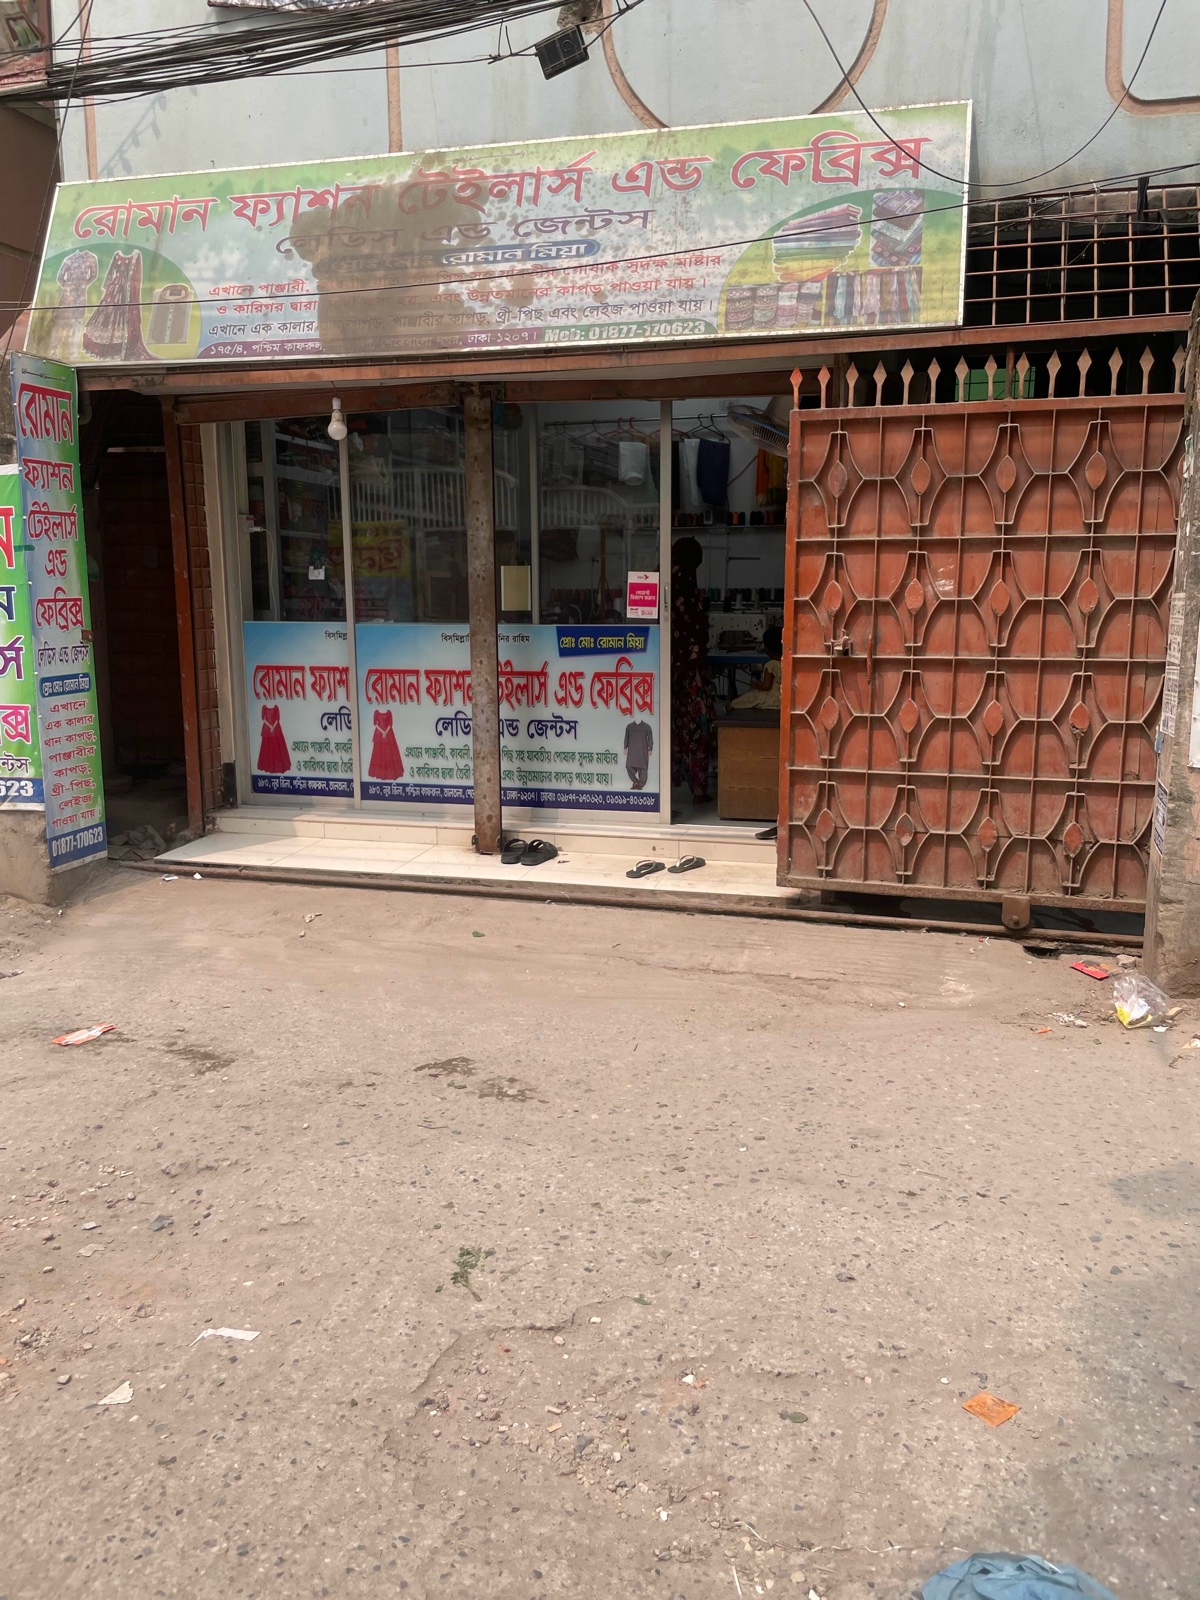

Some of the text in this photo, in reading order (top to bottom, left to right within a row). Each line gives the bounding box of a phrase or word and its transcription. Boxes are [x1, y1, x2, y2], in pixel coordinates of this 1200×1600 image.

[74, 195, 220, 239] রোমান
[228, 181, 384, 227] ফ্যাশন
[398, 151, 597, 213] টেইলার্স
[731, 131, 932, 187] ফেব্রিক্স
[276, 226, 405, 254] লেডিস
[514, 207, 657, 237] জেন্টস
[442, 247, 525, 265] রোমান
[529, 242, 587, 259] মিয়া
[627, 256, 667, 274] সুদক্ষ
[209, 283, 253, 296] এখানে
[258, 278, 310, 295] পাঞ্জাবী,
[216, 304, 228, 315] ও
[234, 301, 285, 314] কারিগর
[290, 300, 318, 312] দ্বারা
[430, 293, 462, 303] এবং
[467, 287, 550, 303] উন্নতমানের
[556, 283, 604, 297] কাপড়
[610, 279, 658, 293] পাওয়া
[209, 323, 247, 337] এখানে
[251, 322, 273, 335] এক
[278, 320, 316, 334] কালার
[449, 312, 491, 328] কাপড়,
[549, 306, 577, 320] এবং
[582, 301, 625, 318] লেইজ
[630, 301, 674, 315] পাওয়া
[544, 321, 706, 342] Mob: 01877-170623
[252, 343, 281, 354] পশ্চিম
[16, 382, 74, 445] রোমান
[21, 457, 74, 492] ফ্যাশন
[27, 500, 78, 541] টেইলার্স
[36, 586, 84, 631] ফেব্রিক্স
[512, 633, 530, 643] রাহিম
[560, 633, 645, 650] প্রোঃ মোঃ রোমান মিয়া
[38, 641, 57, 668] লেডিস
[253, 665, 306, 700] রোমান
[365, 668, 421, 704] রোমান
[590, 655, 655, 716] ফেব্রিক্স
[50, 698, 87, 714] এখানে
[45, 714, 94, 731] এক কালার
[435, 711, 472, 739] লেডি
[527, 712, 579, 740] জেন্টস
[44, 730, 97, 748] থান কাপড়,
[291, 741, 309, 753] এখানে
[48, 745, 96, 764] পাঞ্জাবীর
[296, 761, 302, 771] ও
[303, 757, 325, 772] কারিগর
[327, 762, 339, 773] দ্বারা
[404, 745, 423, 758] এখানে
[515, 749, 525, 762] সহ
[527, 746, 551, 763] যাবতীয়
[553, 751, 576, 763] পোষাক
[577, 751, 594, 767] সুদক্ষ
[52, 763, 92, 779] কাপড়,
[409, 767, 415, 778] ও
[416, 763, 440, 779] কারিগর
[442, 767, 454, 780] দ্বারা
[456, 762, 470, 779] তৈরী
[501, 770, 515, 782] এবং
[516, 767, 552, 787] উন্নতমানের
[554, 771, 573, 786] কাপড়
[575, 772, 594, 785] পাওয়া
[58, 792, 93, 811] লেইজ
[51, 813, 78, 829] পাওয়া
[52, 826, 104, 858] 01877-170623
